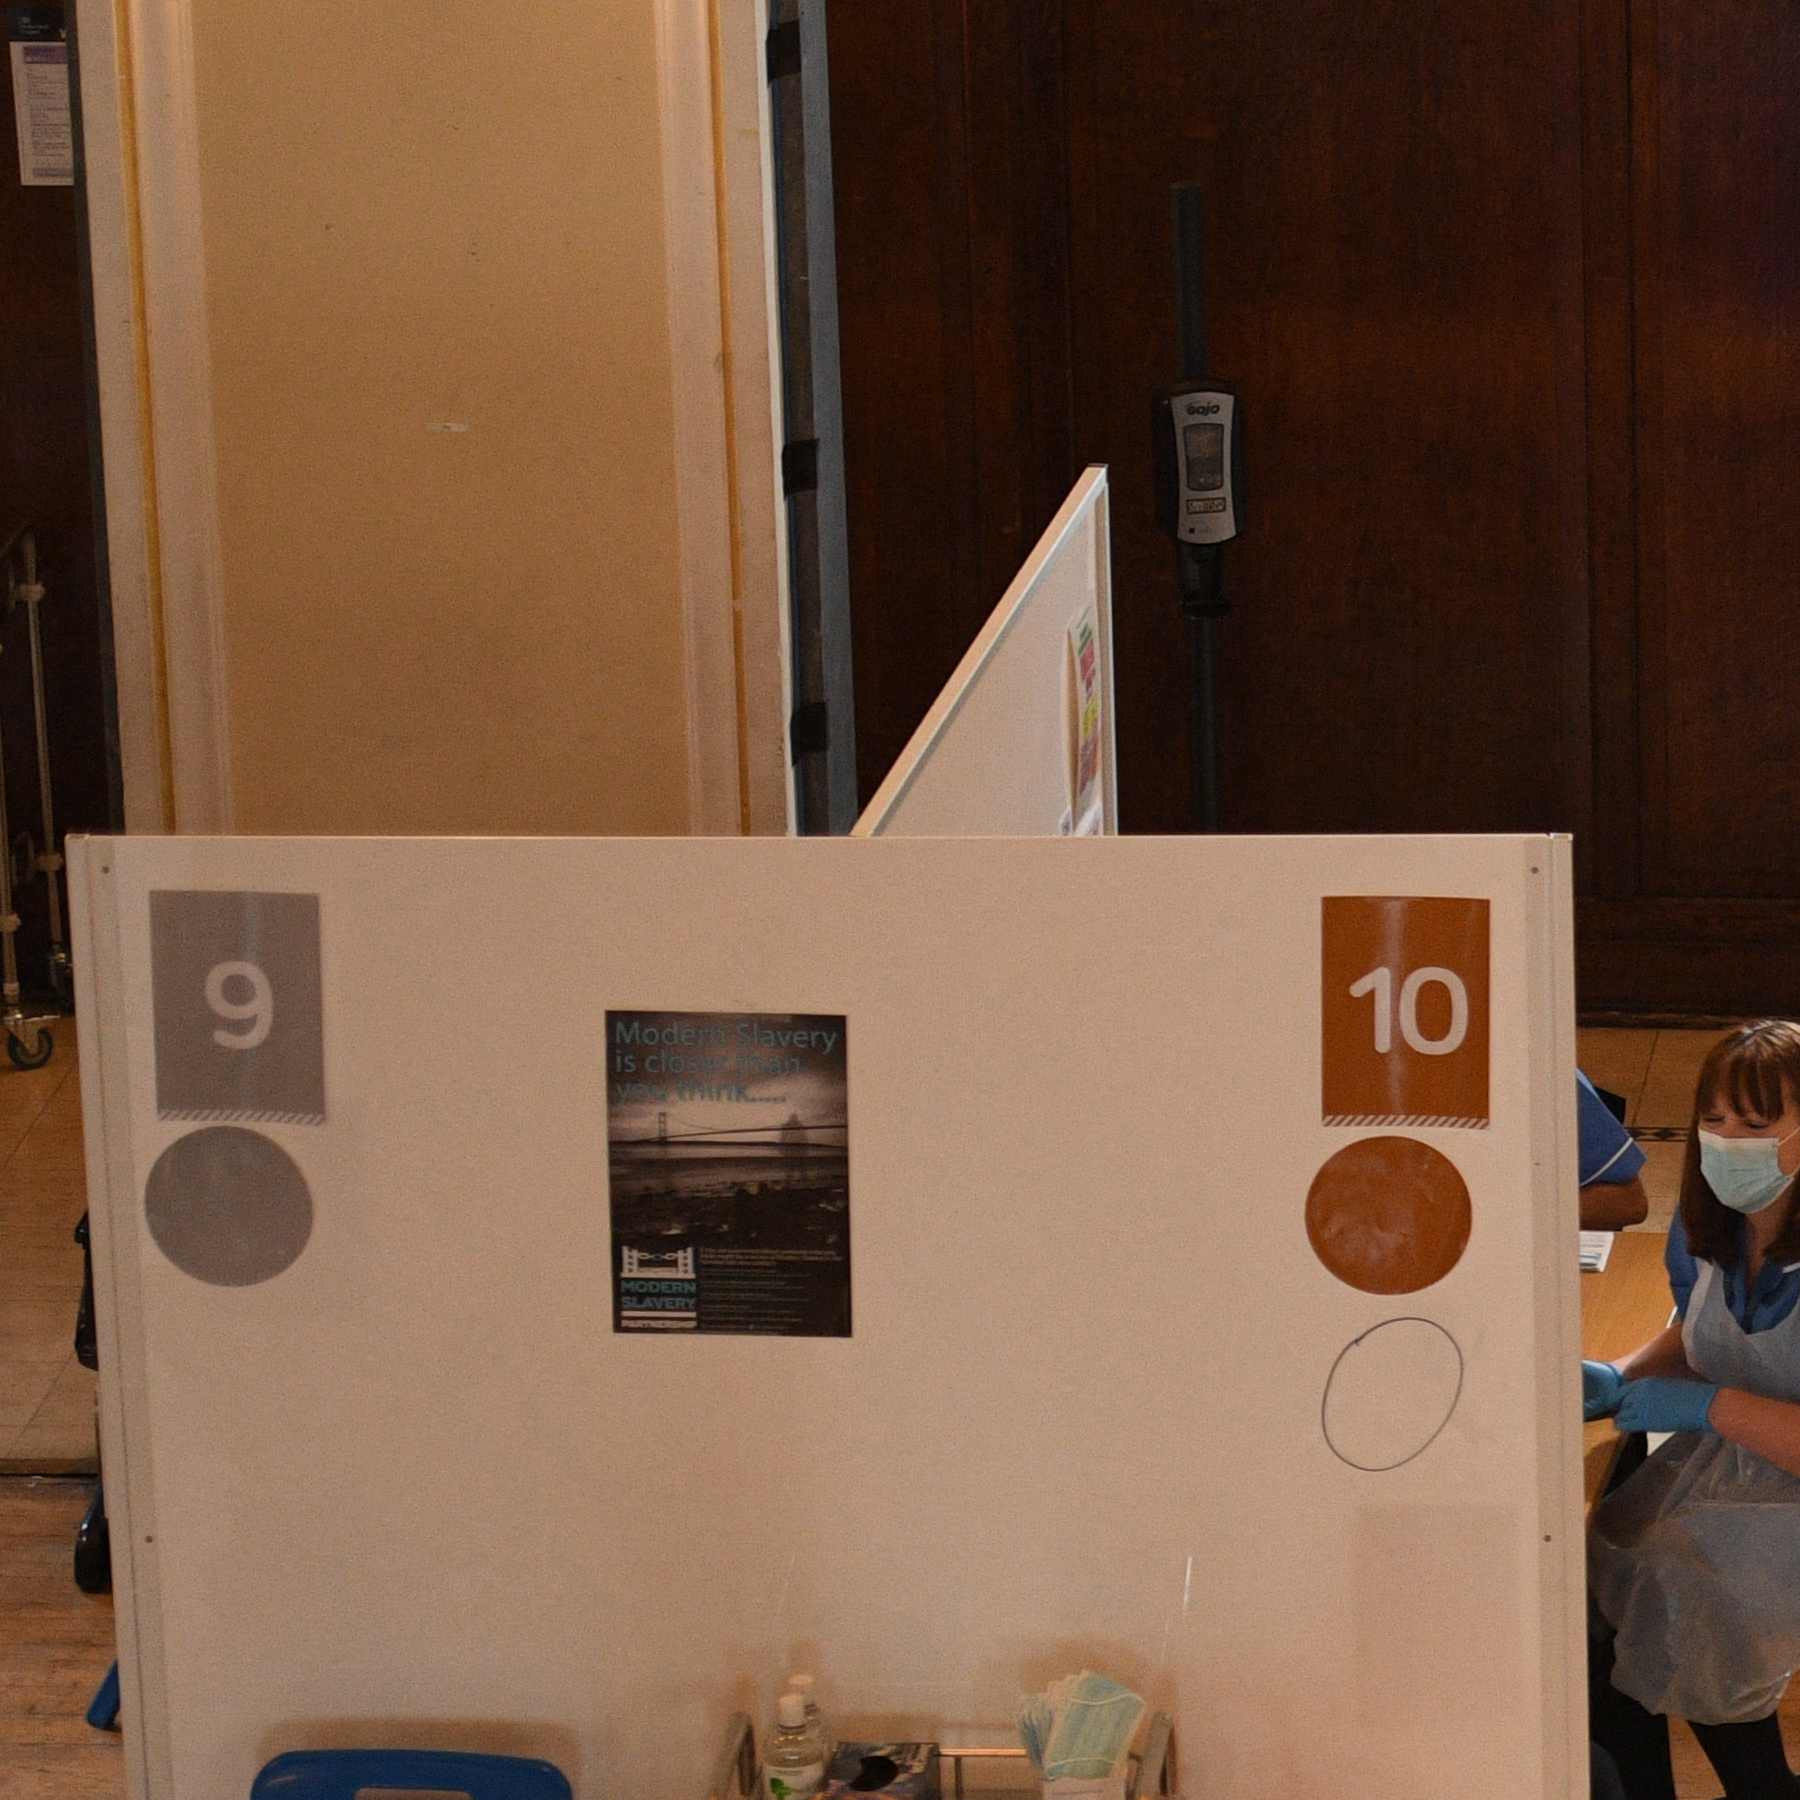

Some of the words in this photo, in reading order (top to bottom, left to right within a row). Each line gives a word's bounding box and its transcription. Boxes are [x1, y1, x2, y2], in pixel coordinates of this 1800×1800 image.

[203, 960, 275, 1050] 9
[1348, 966, 1469, 1056] 10
[614, 1020, 728, 1046] Modern
[736, 1023, 838, 1055] Slavery
[615, 1050, 638, 1073] is
[644, 1051, 729, 1073] closer
[620, 1280, 697, 1294] MODERN
[621, 1297, 696, 1311] SLAVERY
